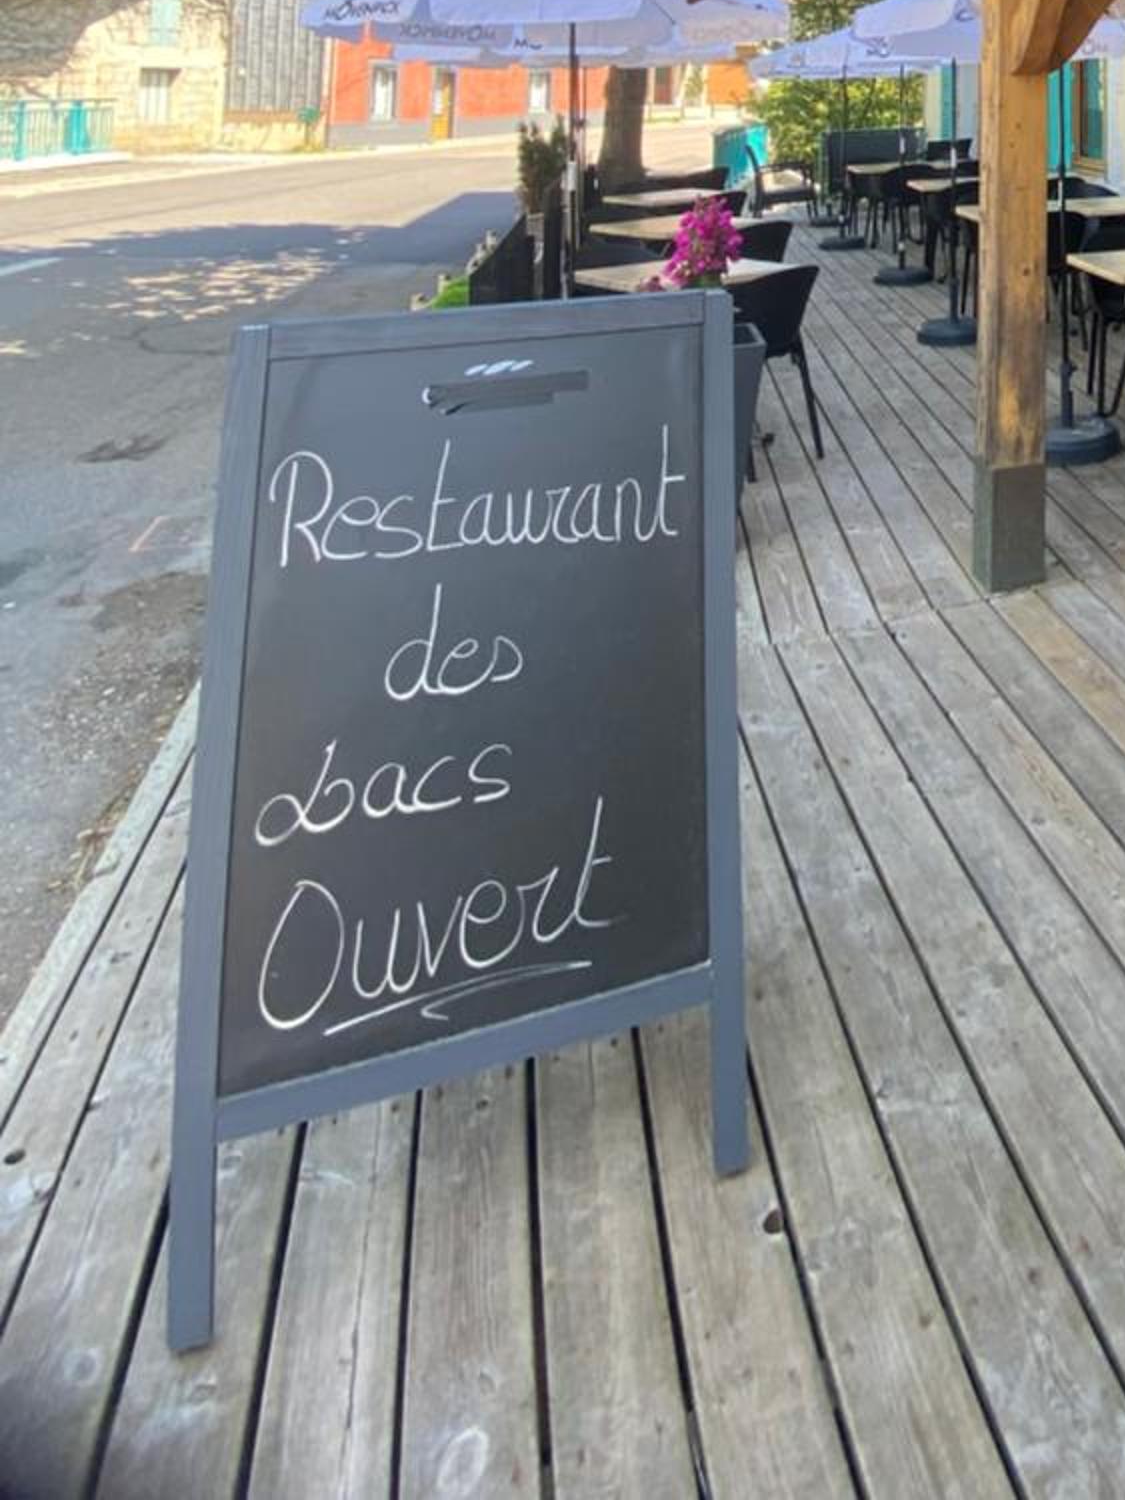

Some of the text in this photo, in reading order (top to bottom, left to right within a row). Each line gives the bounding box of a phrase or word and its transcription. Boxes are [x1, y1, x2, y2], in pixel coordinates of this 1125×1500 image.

[268, 424, 686, 567] Restaurant
[384, 583, 524, 700] des
[257, 796, 620, 1030] Ouvert
